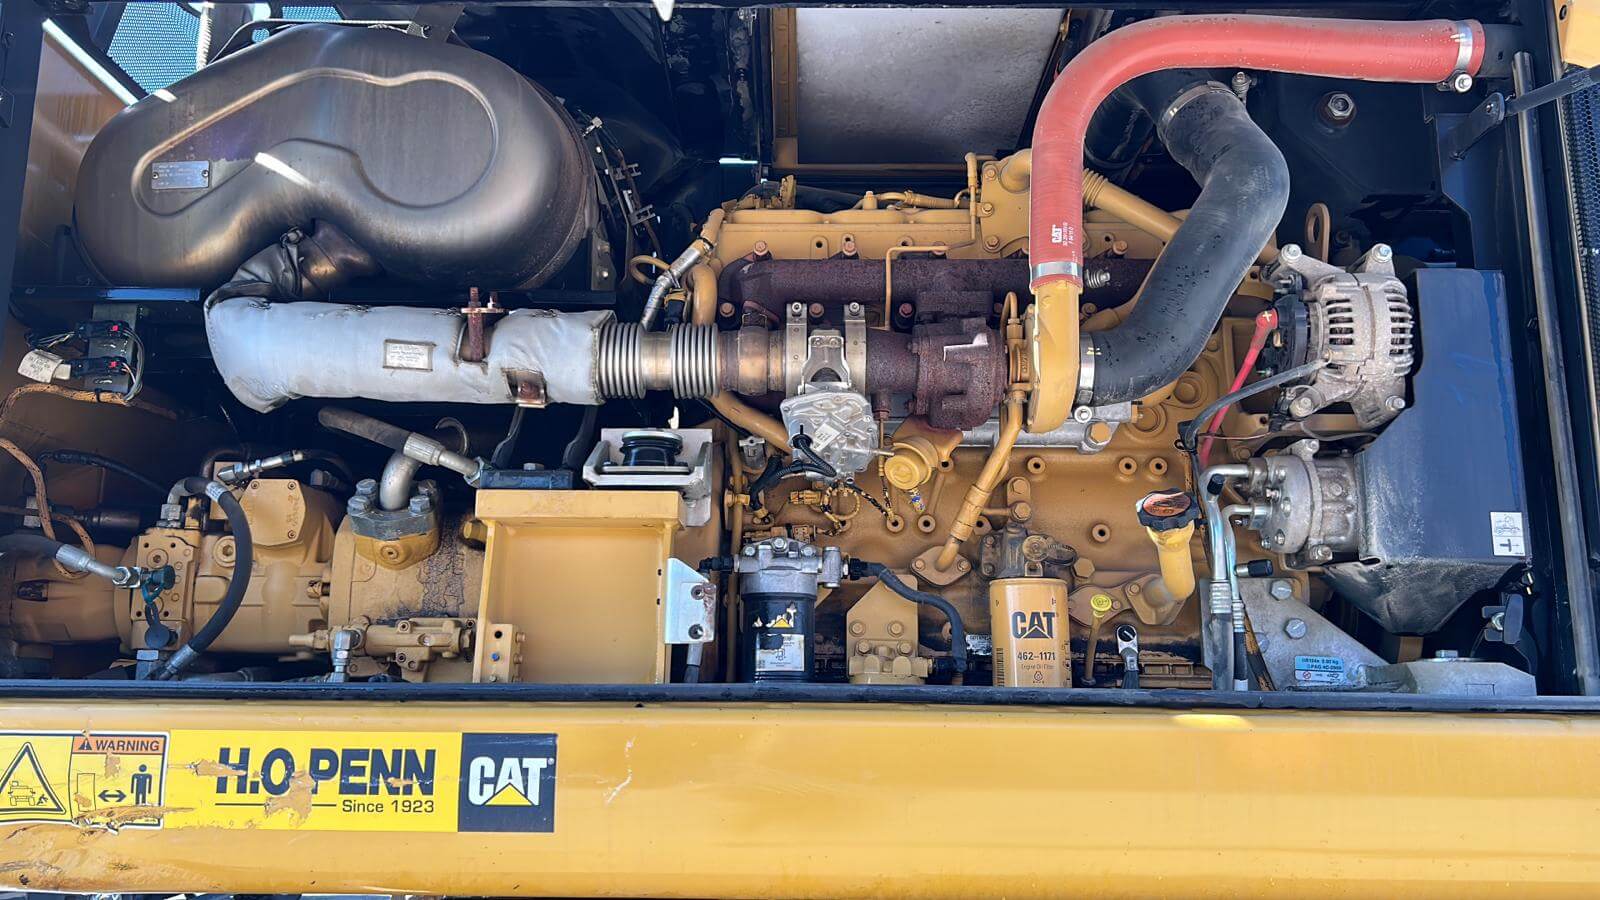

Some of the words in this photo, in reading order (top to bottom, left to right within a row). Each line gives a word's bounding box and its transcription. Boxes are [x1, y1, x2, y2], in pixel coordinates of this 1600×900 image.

[1012, 611, 1056, 639] CAT
[1018, 652, 1056, 661] 462-1171
[96, 740, 159, 752] WARNING
[309, 748, 437, 796] PENN
[468, 756, 548, 806] CAT
[342, 800, 384, 813] Since
[391, 800, 434, 813] 1923
